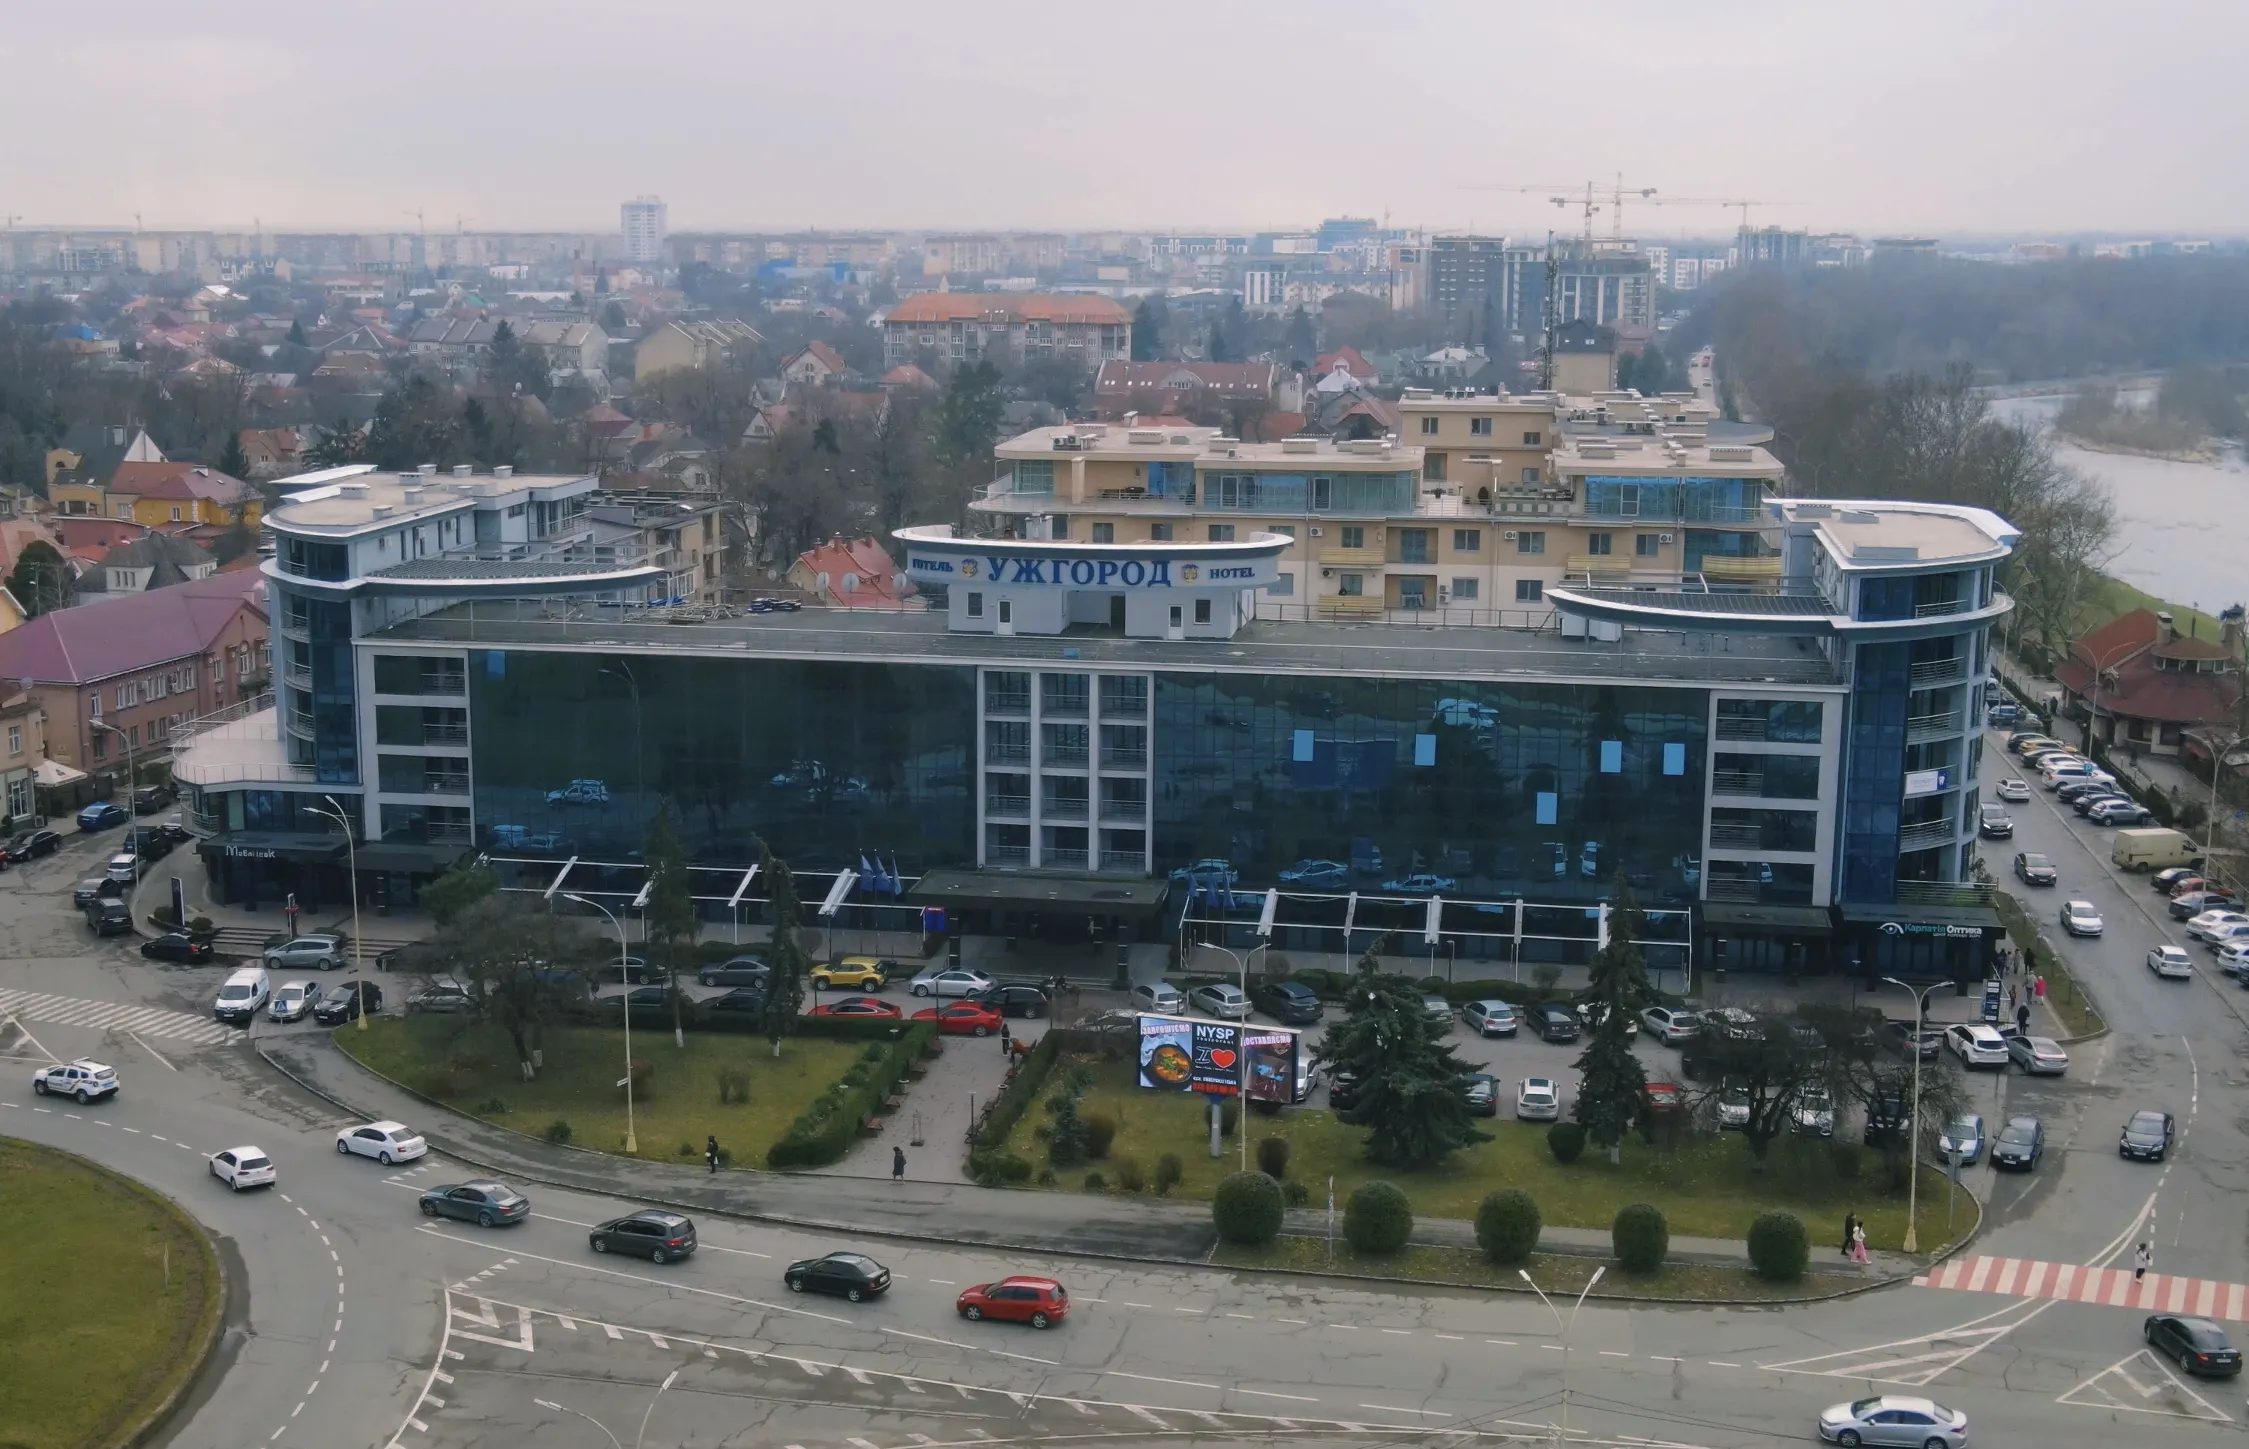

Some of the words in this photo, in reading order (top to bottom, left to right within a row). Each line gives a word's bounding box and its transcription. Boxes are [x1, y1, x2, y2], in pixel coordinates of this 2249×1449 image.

[912, 558, 954, 573] ГОТЕЛЬ
[987, 556, 1171, 588] УЖГОРОД
[1210, 567, 1255, 580] HOTEL
[1904, 923, 1946, 933] Карпатія
[1946, 924, 1983, 935] Оптика
[1196, 1025, 1235, 1040] NYSP
